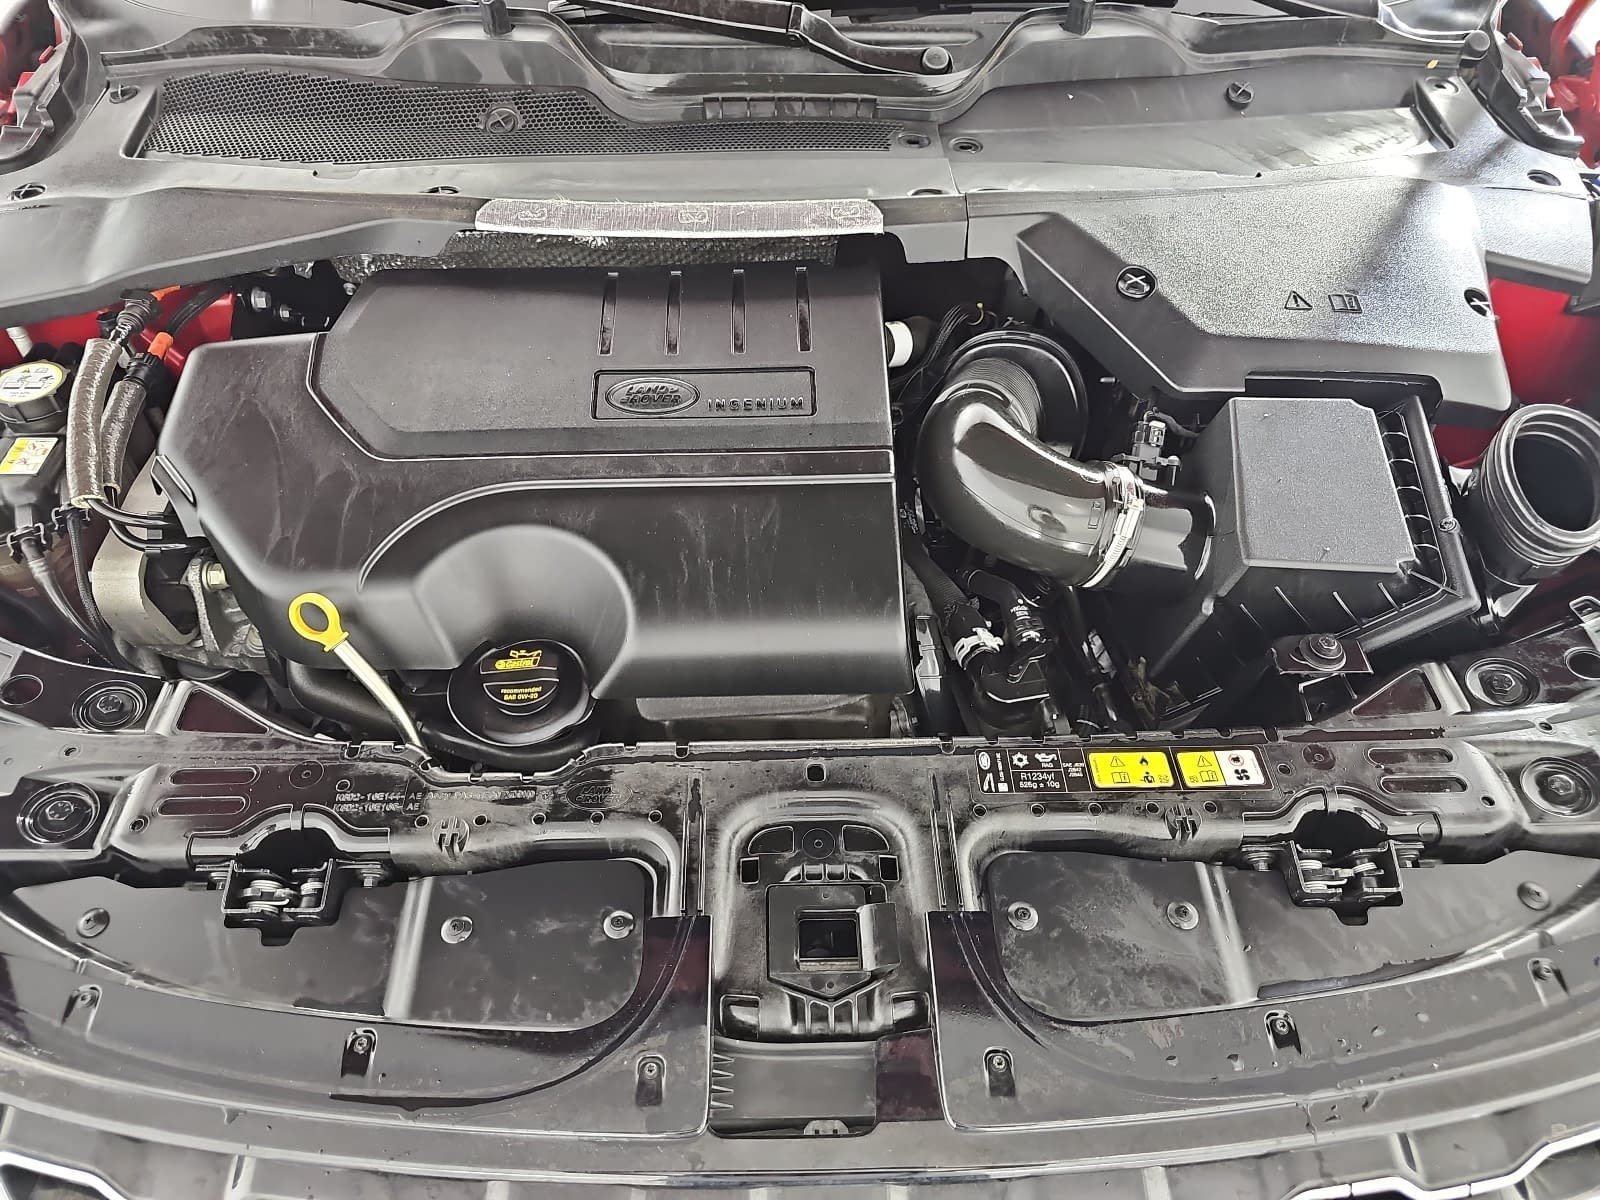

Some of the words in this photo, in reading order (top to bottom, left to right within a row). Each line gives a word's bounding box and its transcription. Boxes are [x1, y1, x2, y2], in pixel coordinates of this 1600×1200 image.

[625, 385, 671, 395] LAND
[629, 394, 682, 405] ROVER
[707, 397, 804, 411] INGENIUM
[505, 659, 532, 668] Castrol
[500, 686, 542, 694] recommended
[1020, 772, 1055, 782] R1234yf
[1046, 781, 1060, 789] 10g
